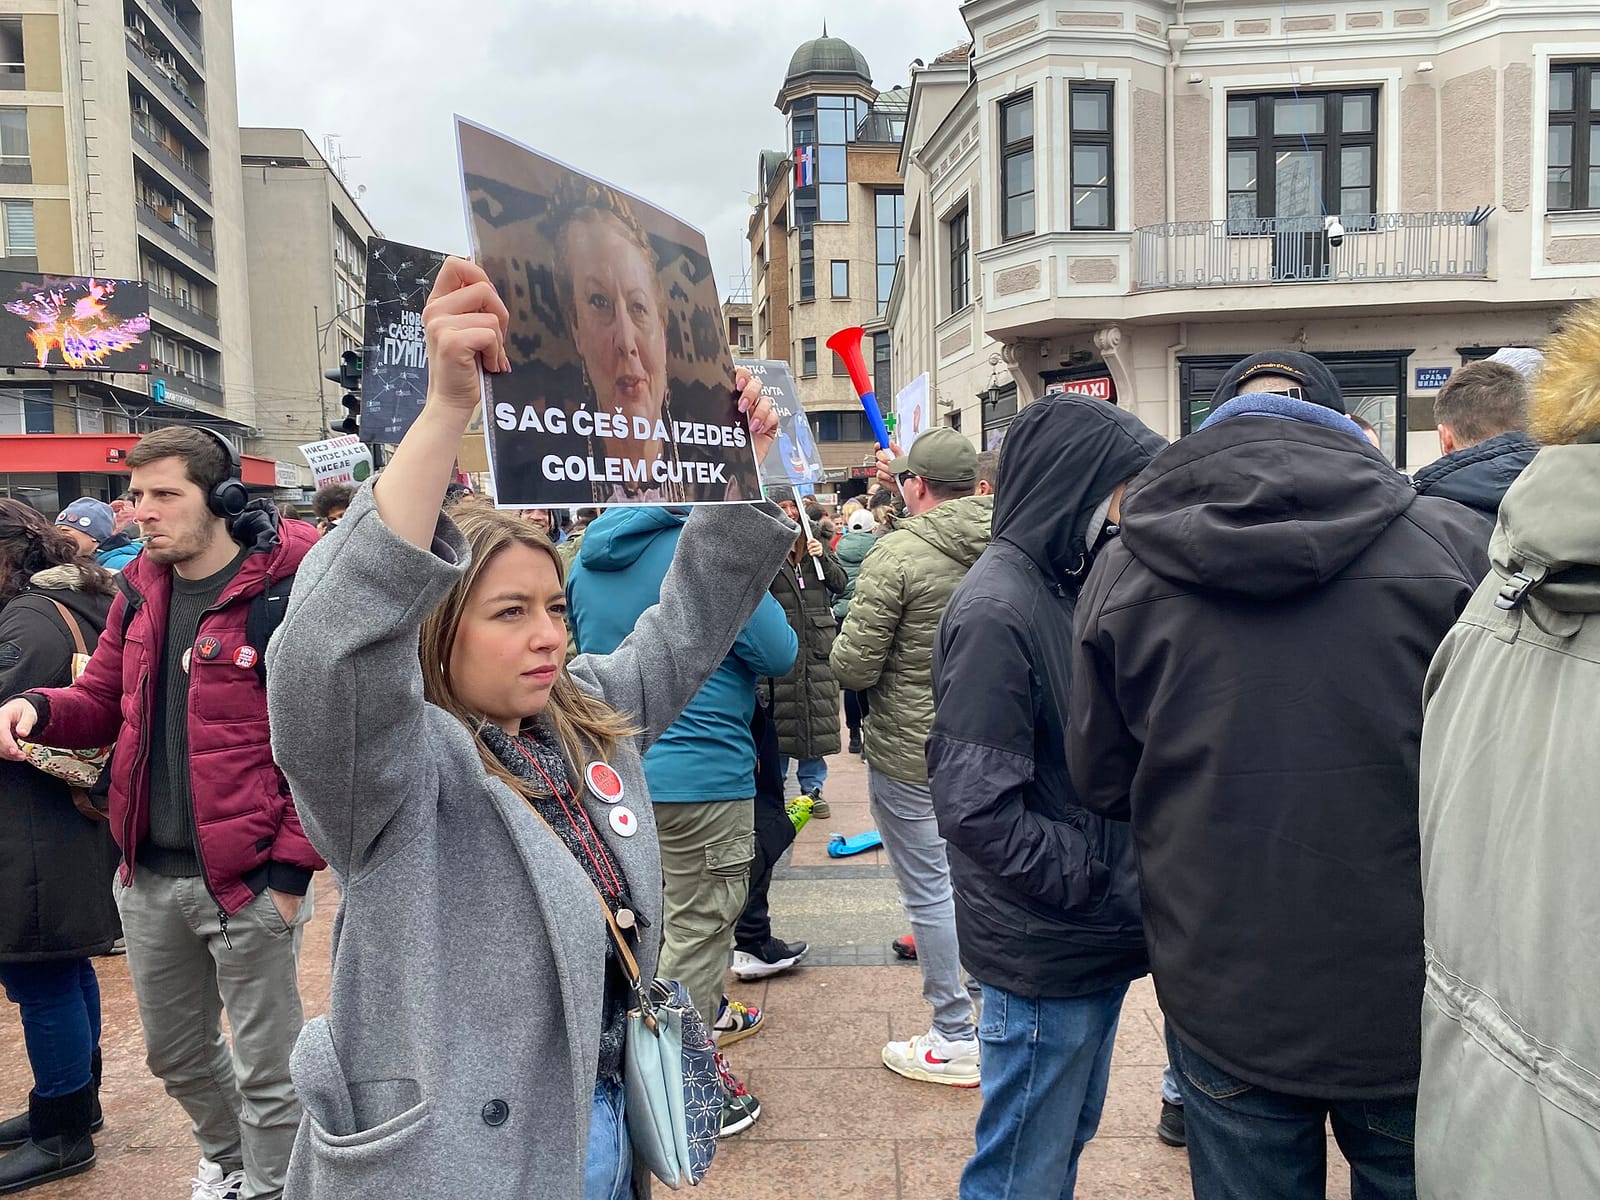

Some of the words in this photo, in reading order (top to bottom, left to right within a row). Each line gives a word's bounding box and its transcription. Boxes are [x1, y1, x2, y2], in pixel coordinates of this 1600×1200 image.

[1067, 382, 1105, 396] MAXI
[494, 402, 568, 434] SAG
[572, 403, 629, 439] ĆEŠ
[632, 415, 671, 442] DA
[674, 421, 747, 448] IZEDEŠ
[304, 443, 329, 455] НИСУ
[309, 452, 341, 465] КУПУС
[353, 445, 367, 454] СЕ
[315, 460, 351, 475] КИСЕЛЕ
[541, 454, 648, 482] GOLEM
[651, 453, 728, 484] ĆUTEK
